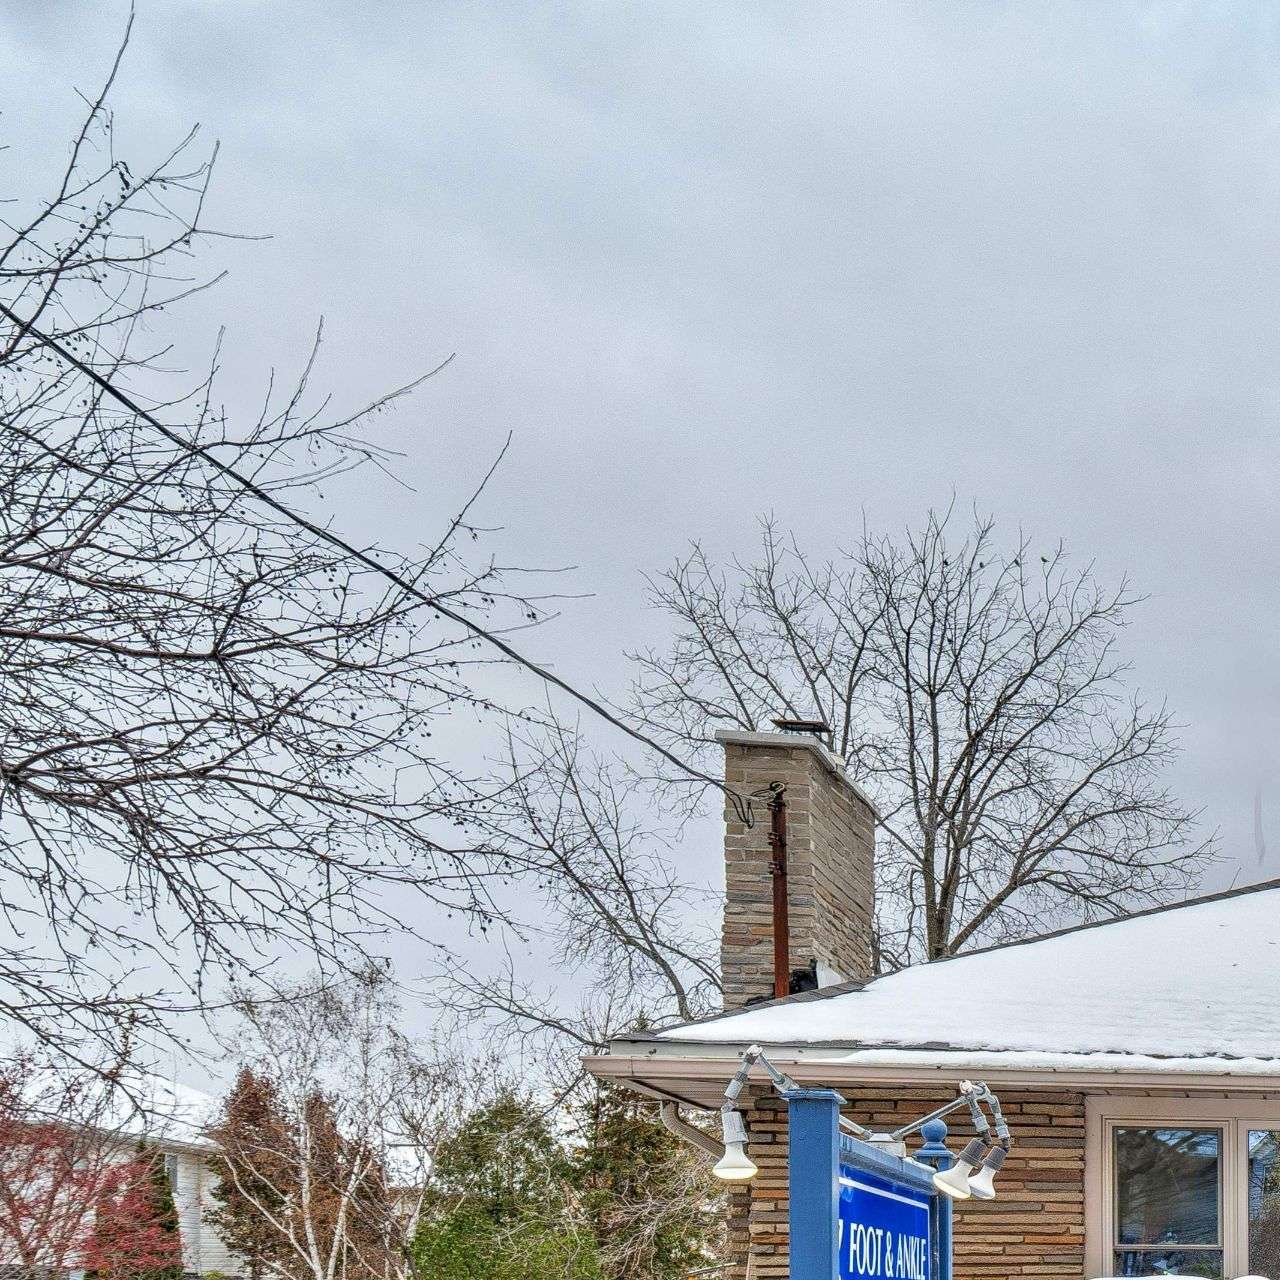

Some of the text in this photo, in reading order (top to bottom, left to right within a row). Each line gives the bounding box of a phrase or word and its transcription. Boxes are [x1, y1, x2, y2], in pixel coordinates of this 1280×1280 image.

[849, 1222, 883, 1276] FOOT
[885, 1231, 894, 1278] &
[896, 1232, 926, 1280] ANKLE
